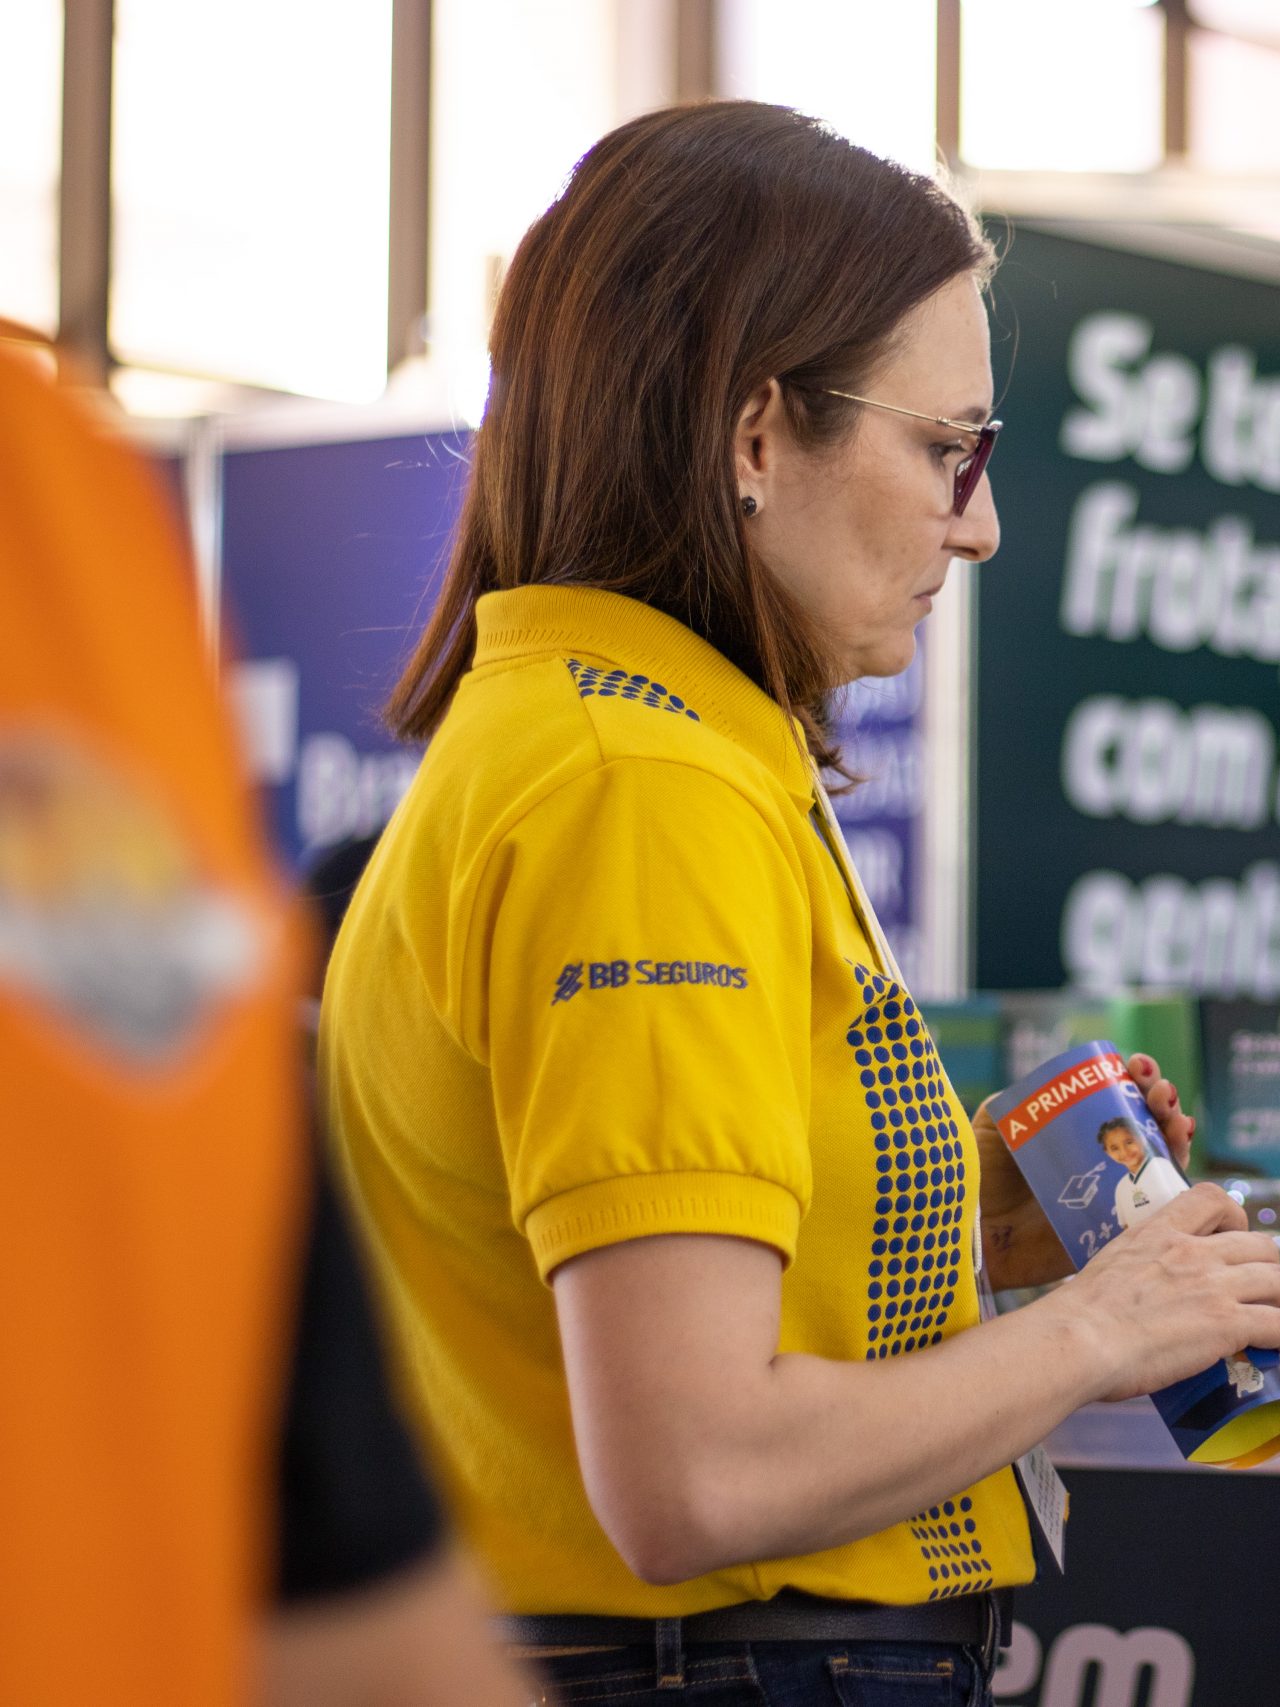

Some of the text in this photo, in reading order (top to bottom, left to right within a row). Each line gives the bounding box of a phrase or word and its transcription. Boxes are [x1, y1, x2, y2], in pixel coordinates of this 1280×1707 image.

[1062, 311, 1202, 475] Se
[1062, 694, 1276, 832] com
[589, 959, 748, 989] BB SEGUROS
[1008, 1060, 1128, 1141] A PRIMEIRA
